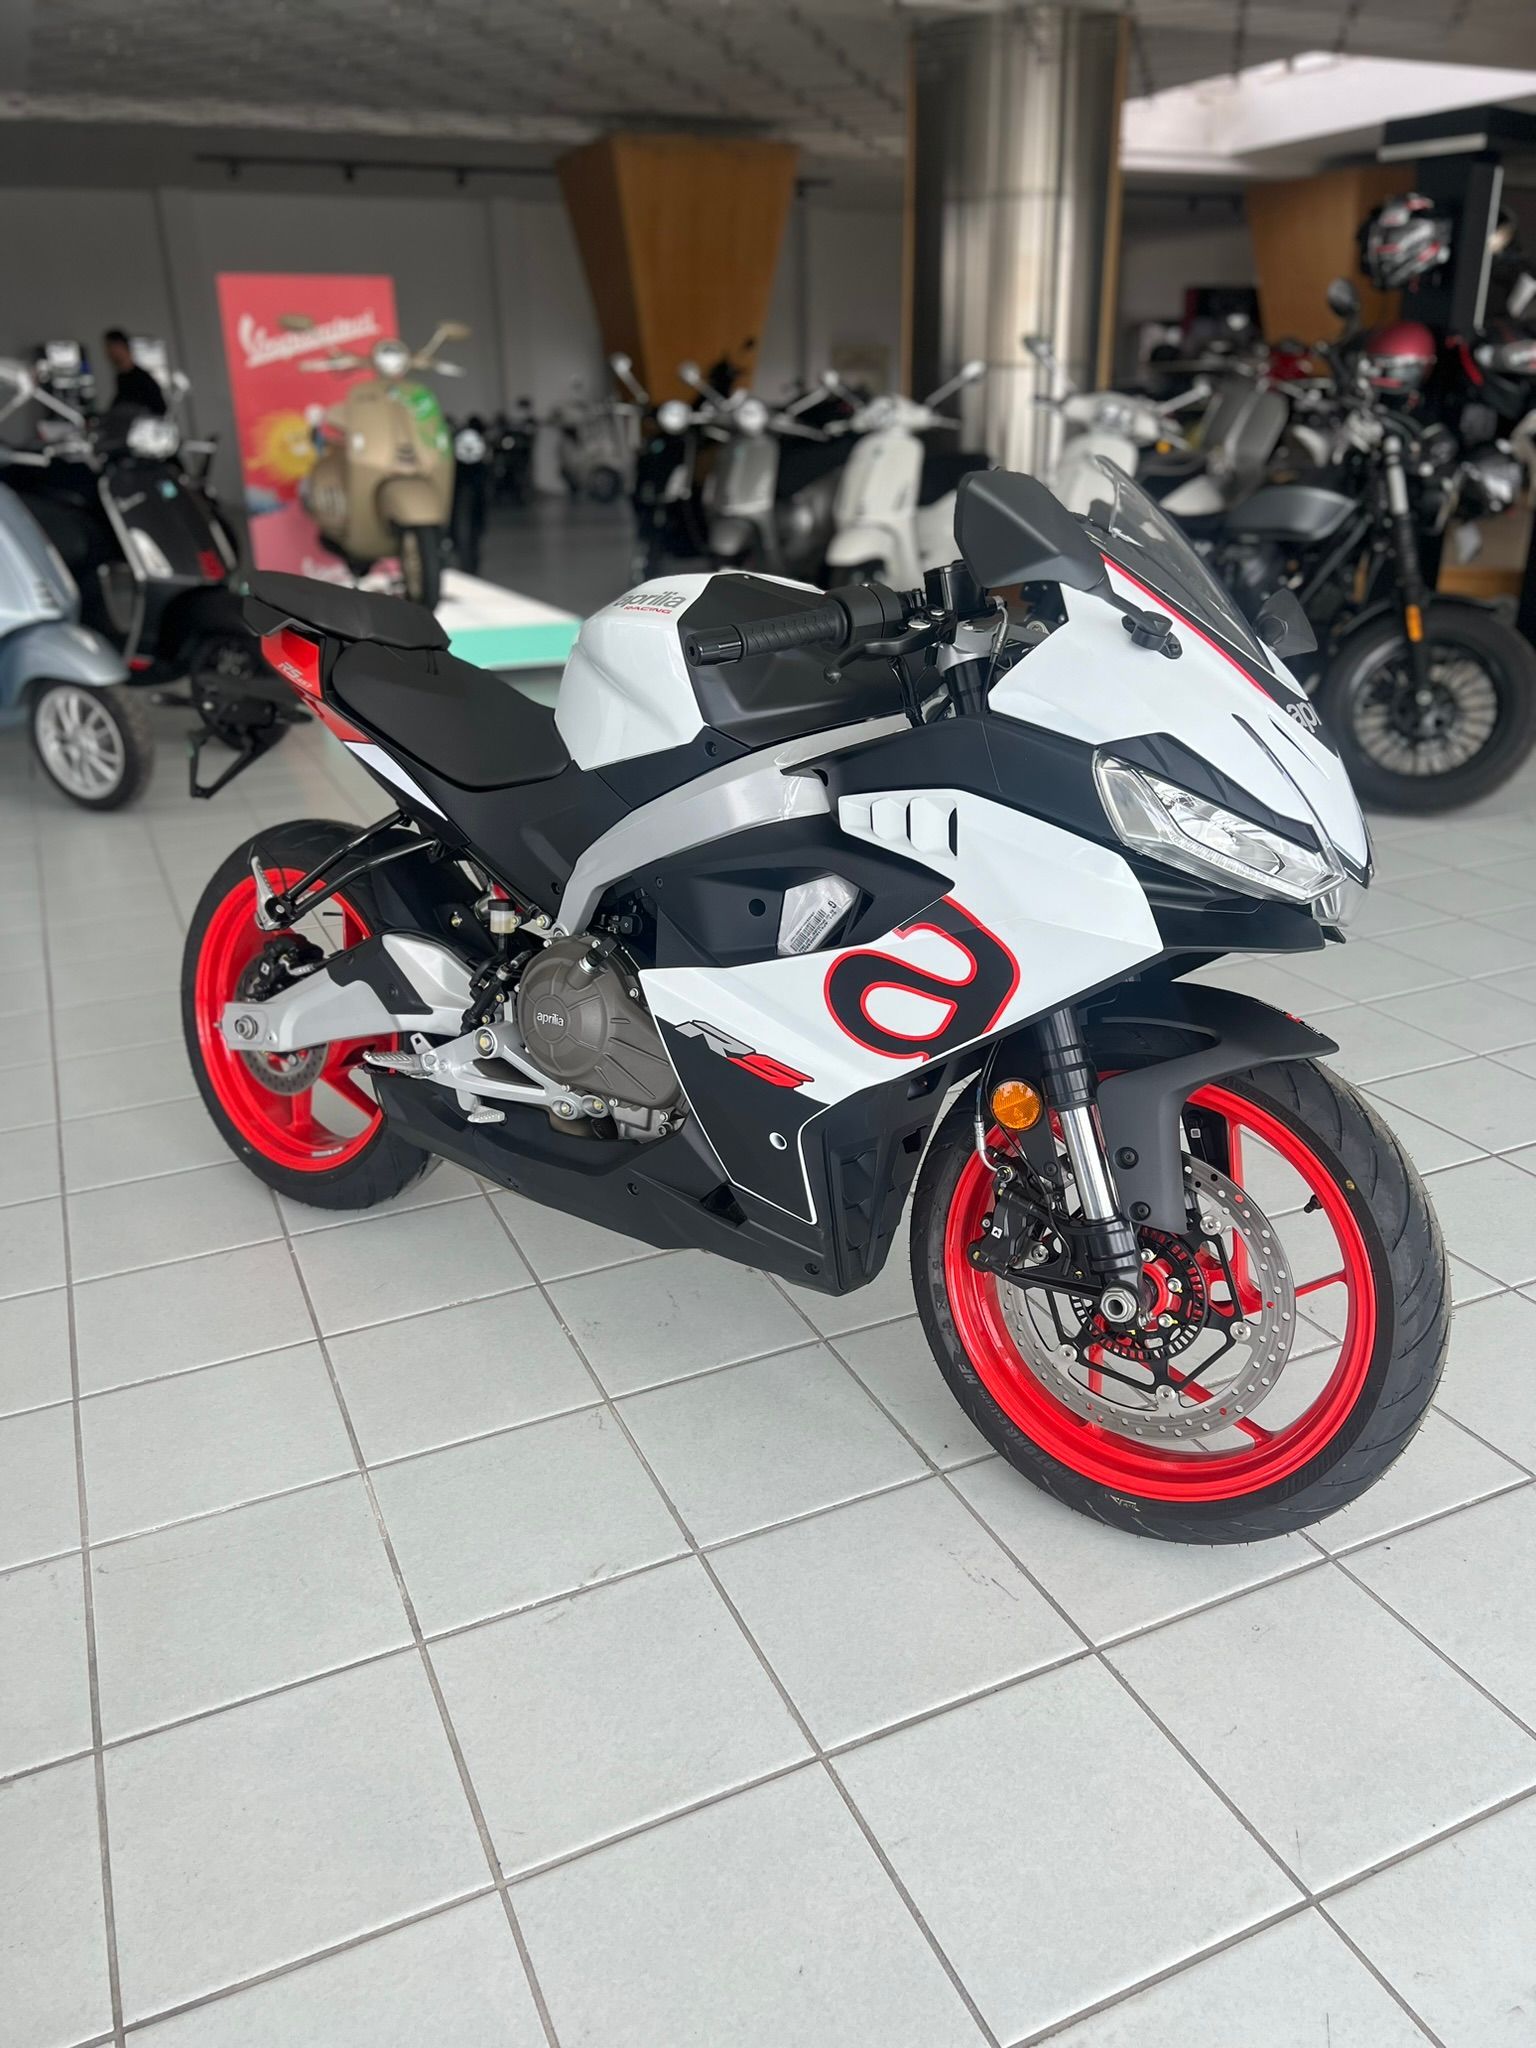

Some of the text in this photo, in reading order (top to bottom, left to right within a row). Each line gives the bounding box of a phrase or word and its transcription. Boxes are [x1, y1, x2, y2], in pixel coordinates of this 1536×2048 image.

[623, 605, 673, 615] RACING
[536, 1012, 564, 1026] aprilia
[674, 1020, 815, 1088] RS
